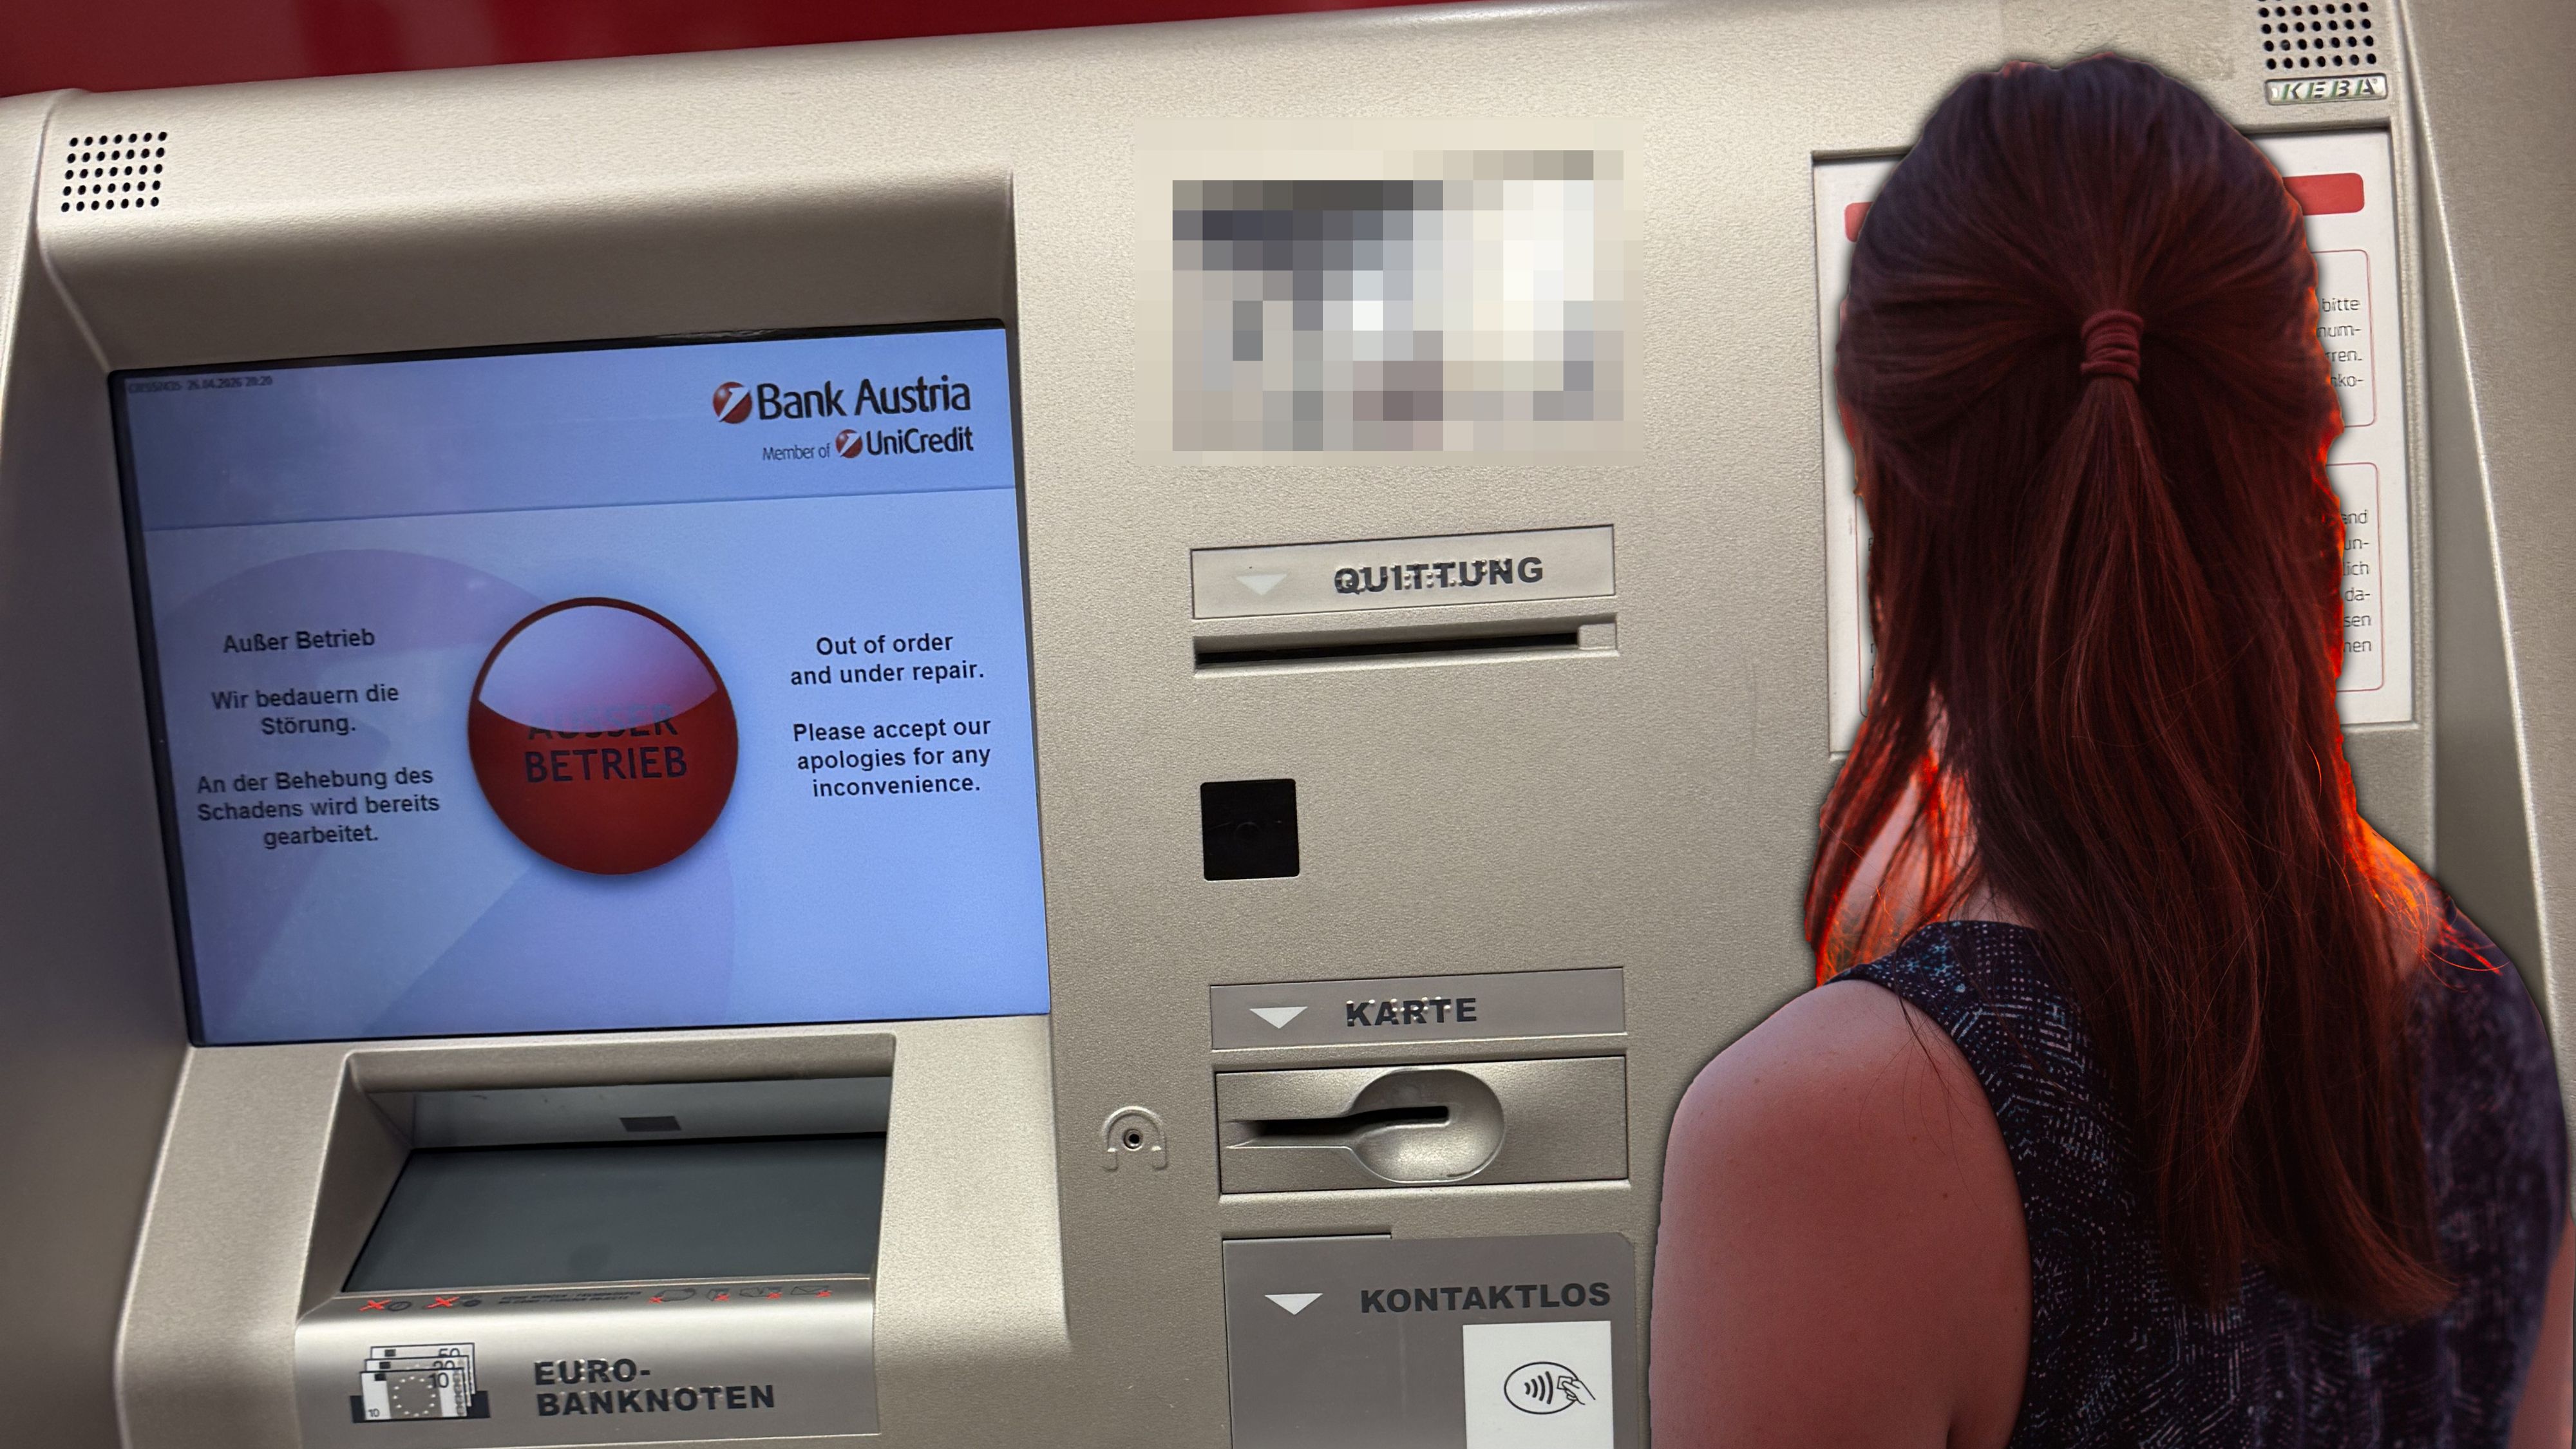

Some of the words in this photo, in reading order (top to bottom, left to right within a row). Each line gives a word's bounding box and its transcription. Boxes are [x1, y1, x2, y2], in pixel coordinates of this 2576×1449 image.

[2281, 78, 2376, 100] KEBA
[2322, 298, 2360, 312] bitte
[757, 381, 848, 421] Bank
[854, 374, 971, 416] Austria
[762, 444, 815, 461] Member
[818, 443, 831, 459] of
[866, 426, 974, 456] UniCredit
[1334, 556, 1544, 594] QUITTUNG
[2345, 587, 2371, 601] da-
[223, 633, 290, 653] Außer
[296, 628, 375, 650] Betrieb
[816, 636, 857, 656] Out
[864, 635, 886, 653] of
[893, 633, 953, 652] order
[791, 665, 831, 685] and
[840, 664, 904, 683] under
[913, 660, 984, 684] repair.
[211, 690, 249, 709] Wir
[256, 688, 358, 707] bedauern
[366, 683, 399, 702] die
[261, 715, 356, 735] Störung.
[527, 703, 679, 740] AUSSER
[793, 723, 866, 741] Please
[873, 719, 947, 741] accept
[953, 720, 990, 735] our
[524, 746, 687, 783] BETRIEB
[797, 749, 905, 773] apologies
[914, 747, 944, 765] for
[952, 748, 990, 767] any
[197, 776, 226, 793] An
[234, 774, 268, 792] der
[276, 770, 386, 790] Behebung
[395, 767, 433, 784] des
[812, 775, 980, 797] inconvenience.
[197, 800, 303, 821] Schadens
[310, 797, 357, 817] wird
[365, 794, 440, 813] bereits
[263, 824, 379, 849] gearbeitet.
[1345, 997, 1477, 1027] KARTE
[1360, 1282, 1610, 1314] KONTAKTLOS
[428, 1372, 450, 1388] 10
[533, 1357, 652, 1386] EURO-
[368, 1408, 380, 1417] 10
[535, 1383, 775, 1417] BANKNOTEN
